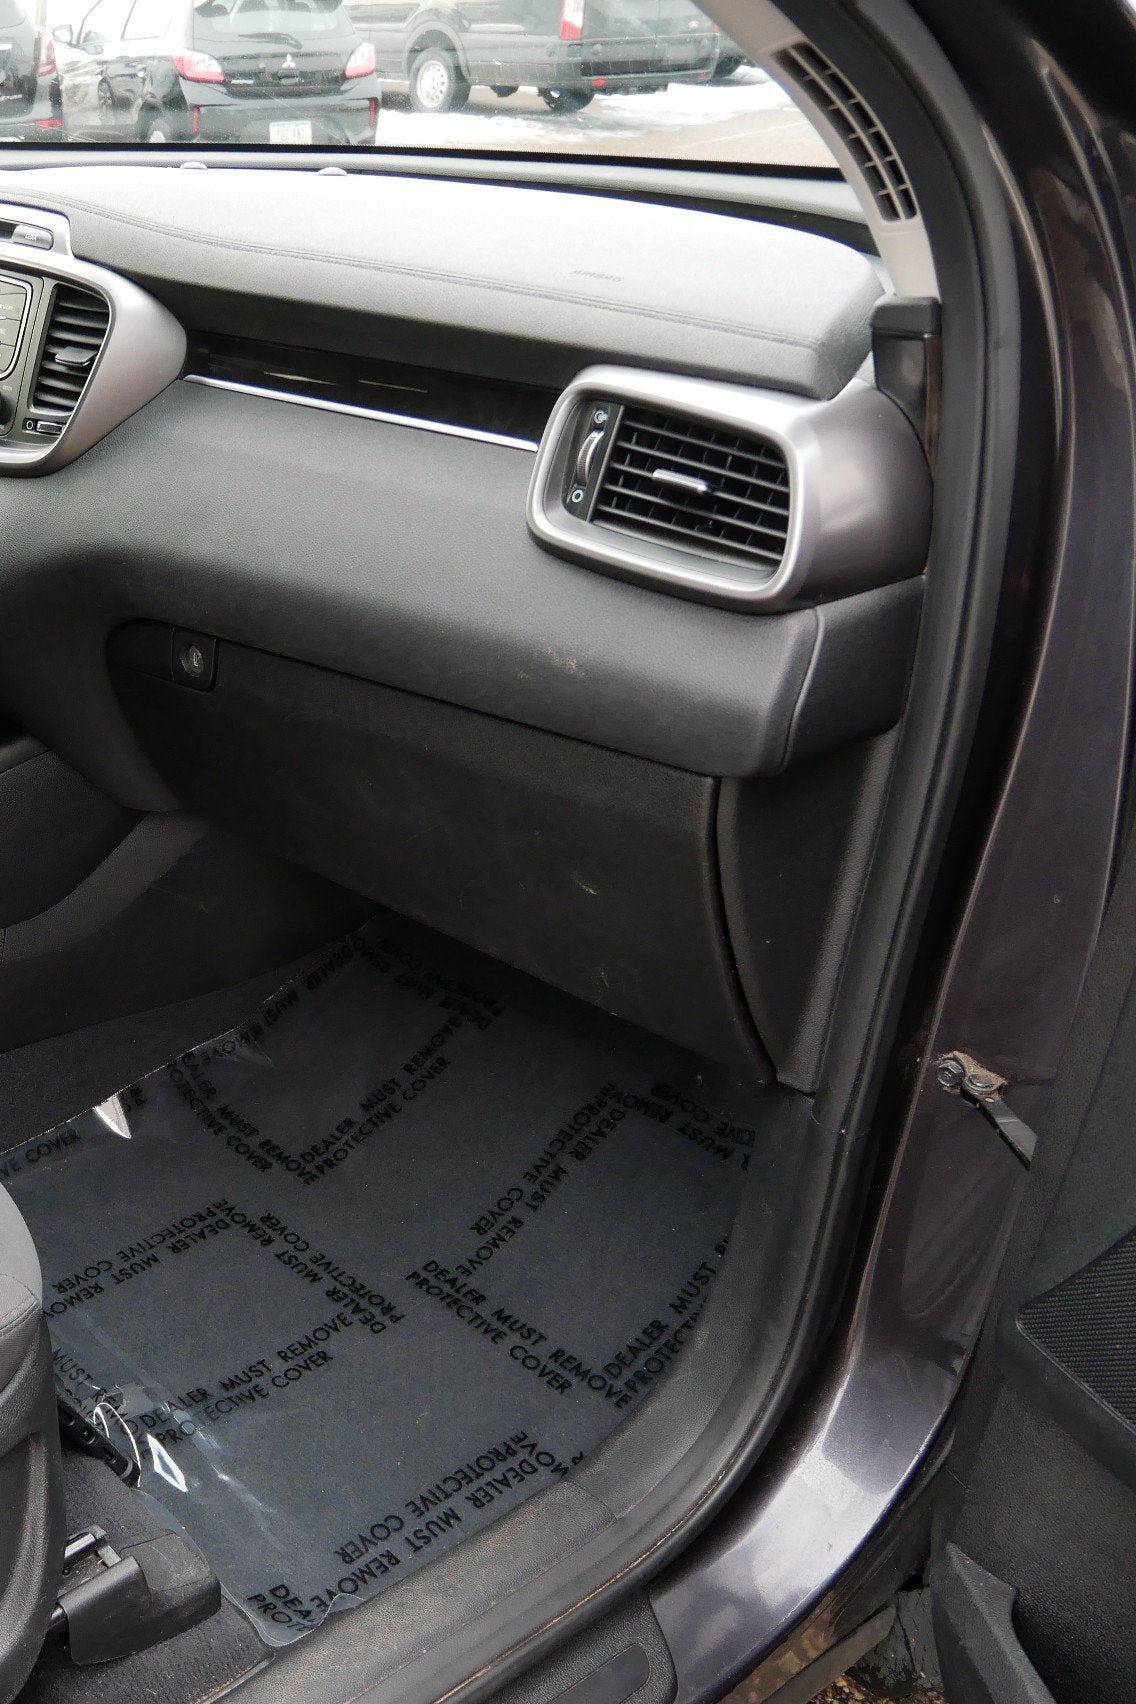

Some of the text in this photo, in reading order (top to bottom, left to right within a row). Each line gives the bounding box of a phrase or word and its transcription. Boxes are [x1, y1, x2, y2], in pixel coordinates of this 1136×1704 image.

[218, 1104, 259, 1138] MUST
[257, 1138, 319, 1186] REMOVE
[299, 1014, 464, 1166] DEALER MUST REMOVE
[314, 1056, 452, 1176] PROTECTIVE COVER
[676, 1121, 735, 1162] MUST
[225, 1134, 274, 1174] COVER
[454, 1106, 626, 1280] DEALER MUST REMOVE
[469, 1095, 609, 1237] PROTECTIVE COVER
[51, 1204, 218, 1294] PROTECTIVE COVER
[112, 1252, 161, 1286] MUST
[167, 1216, 233, 1256] DEALER
[213, 1197, 389, 1336] DEALER MUST REMOVE
[259, 1211, 408, 1327] PROTECTIVE COVER
[139, 1385, 215, 1431] DEALER
[218, 1357, 274, 1393] MUST
[275, 1309, 356, 1365] REMOVE
[404, 1270, 574, 1395] PROTECTIVE COVER
[422, 1259, 633, 1410] DEALER MUST REMOVE
[603, 1261, 718, 1380] DEALER MUST
[155, 1382, 271, 1449] PROTECTIVE
[270, 1348, 335, 1391] COVER
[333, 1439, 519, 1565] PROTECTIVE COVER
[406, 1507, 464, 1554] MUST
[464, 1458, 537, 1511] DEALER
